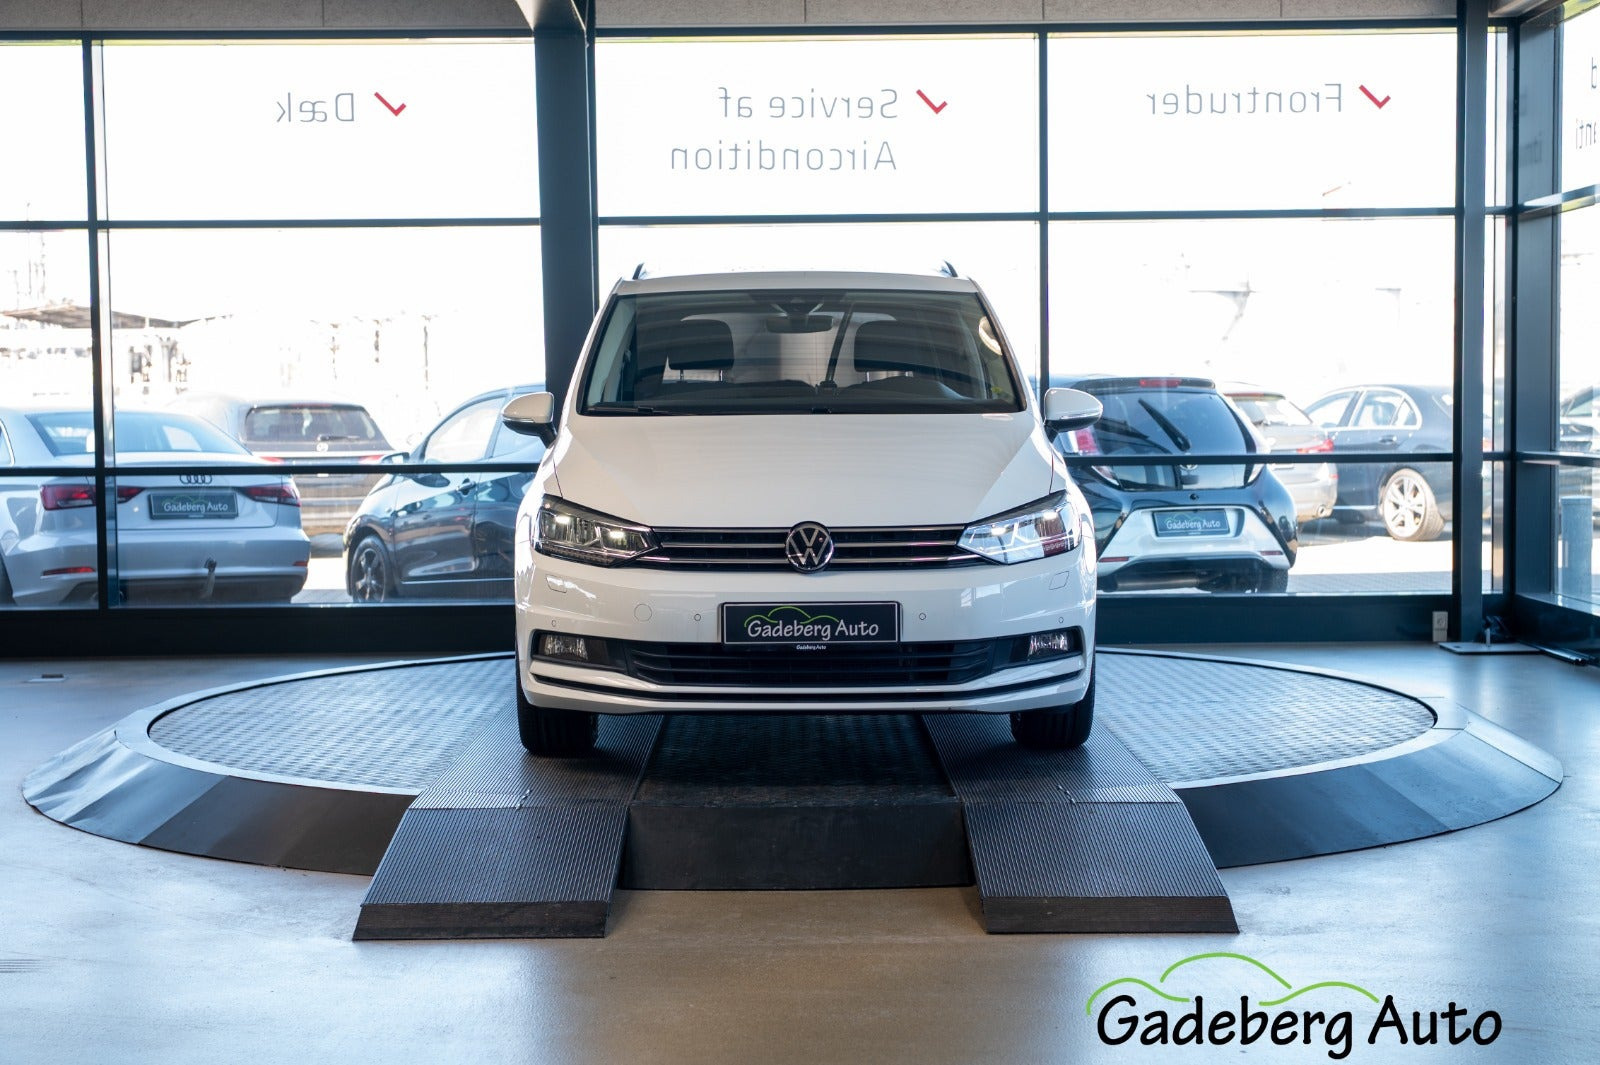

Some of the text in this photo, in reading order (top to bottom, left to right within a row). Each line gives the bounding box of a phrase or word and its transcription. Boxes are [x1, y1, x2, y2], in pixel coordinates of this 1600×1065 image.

[163, 501, 228, 513] Gadeberg Auto
[1166, 519, 1220, 531] Gadeberg Auto
[747, 619, 879, 641] Gadeberg Auto
